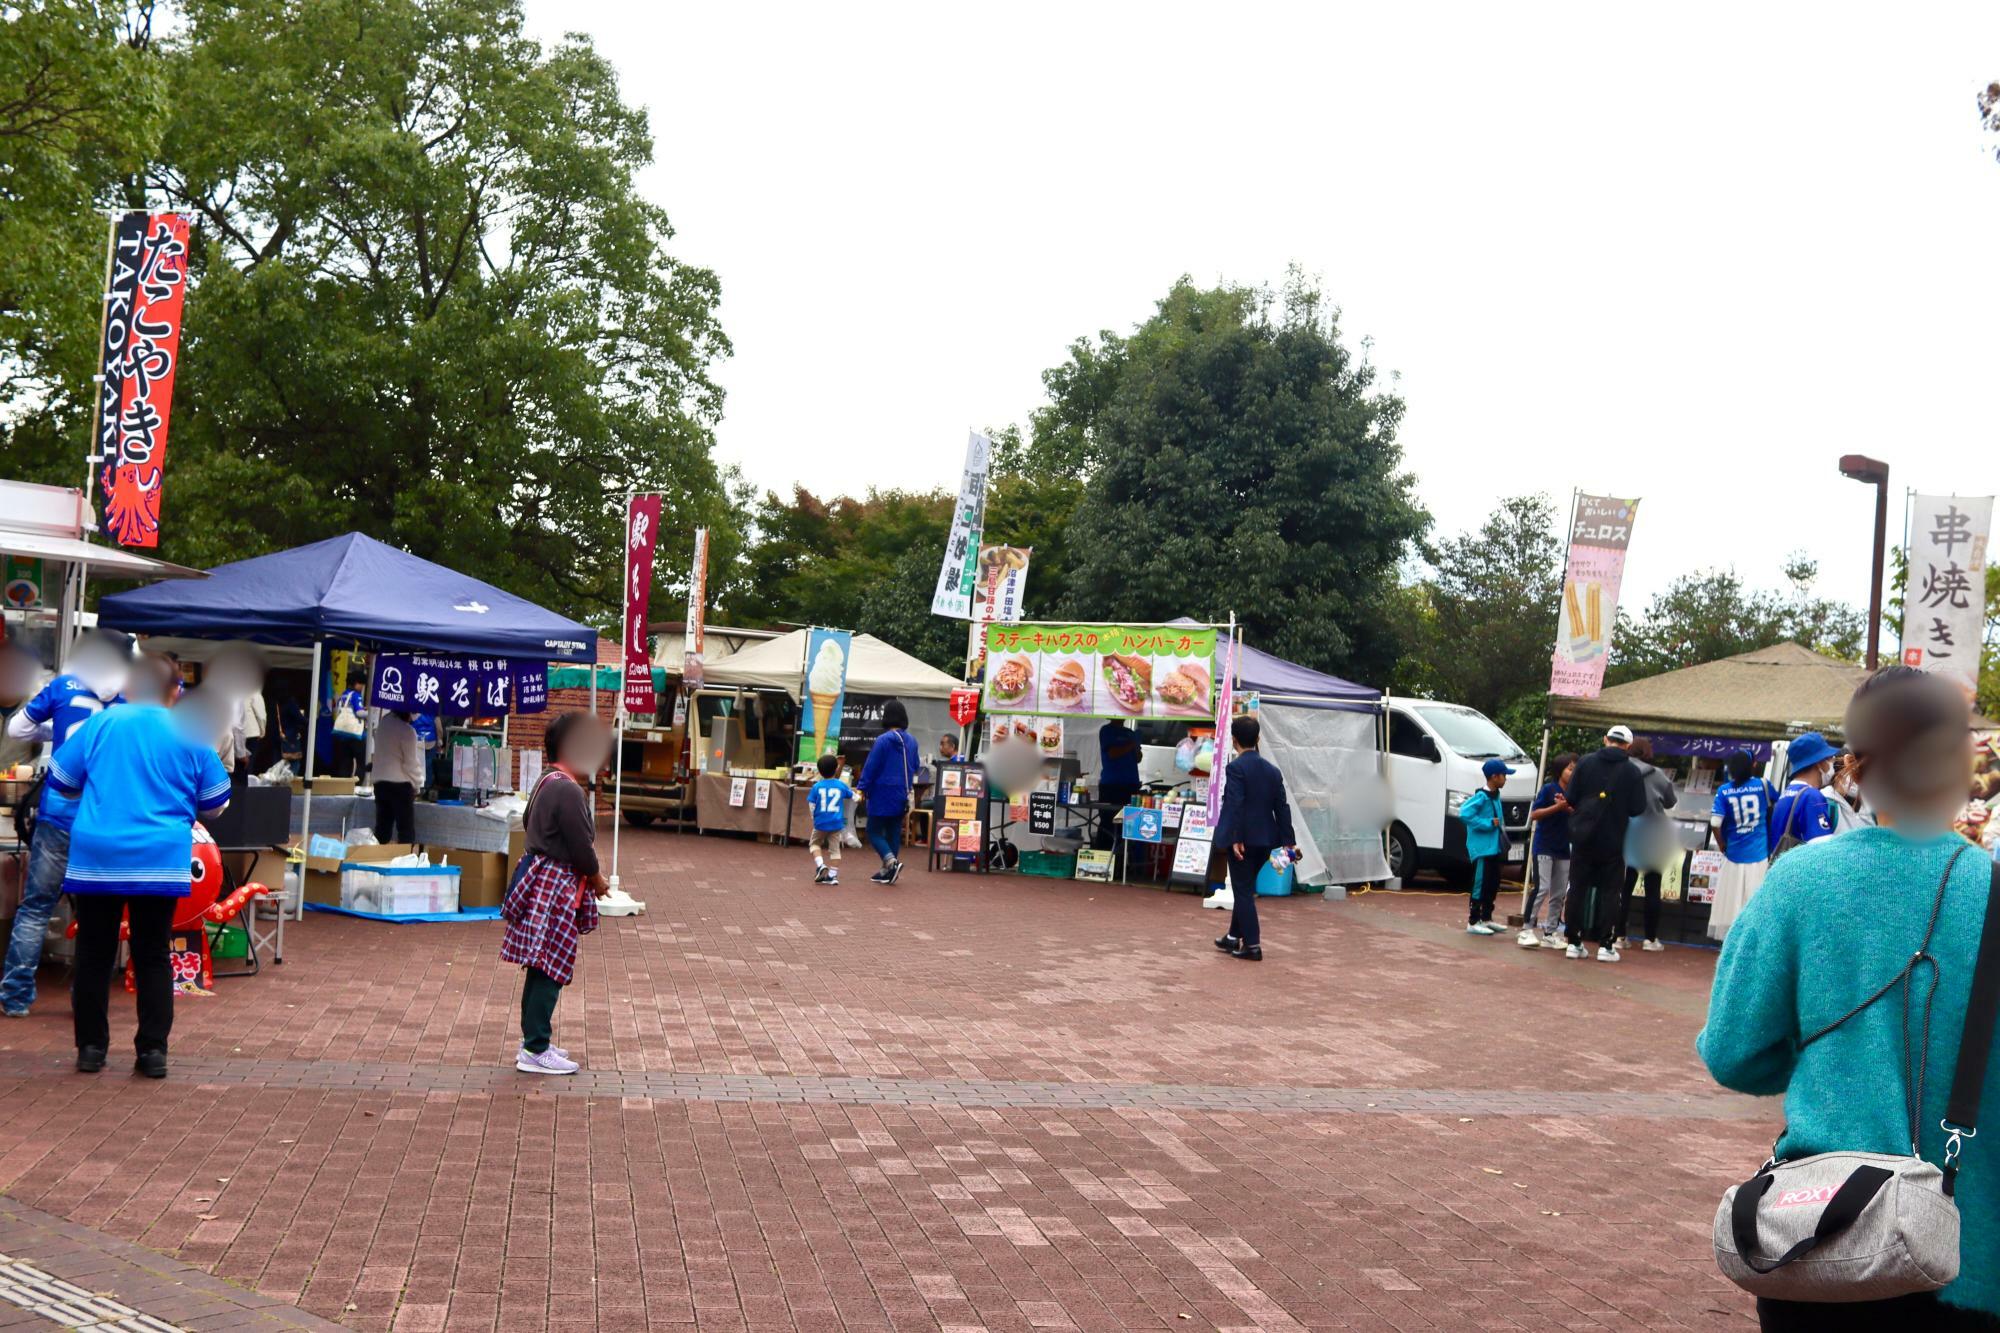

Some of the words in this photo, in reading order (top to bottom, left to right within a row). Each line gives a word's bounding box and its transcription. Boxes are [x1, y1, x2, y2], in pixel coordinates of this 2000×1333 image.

[103, 230, 143, 458] TAKOYAKI
[120, 223, 184, 465] たこやき
[1575, 521, 1627, 541] チュロス
[1919, 505, 1973, 659] 串焼き
[544, 640, 571, 648] CAPTAIN
[571, 641, 586, 650] STAG
[995, 632, 1099, 647] ステーキハウスの
[414, 672, 509, 708] 駅そば
[817, 787, 841, 813] 12
[1728, 794, 1760, 828] 18
[1780, 1184, 1839, 1206] ROXY
